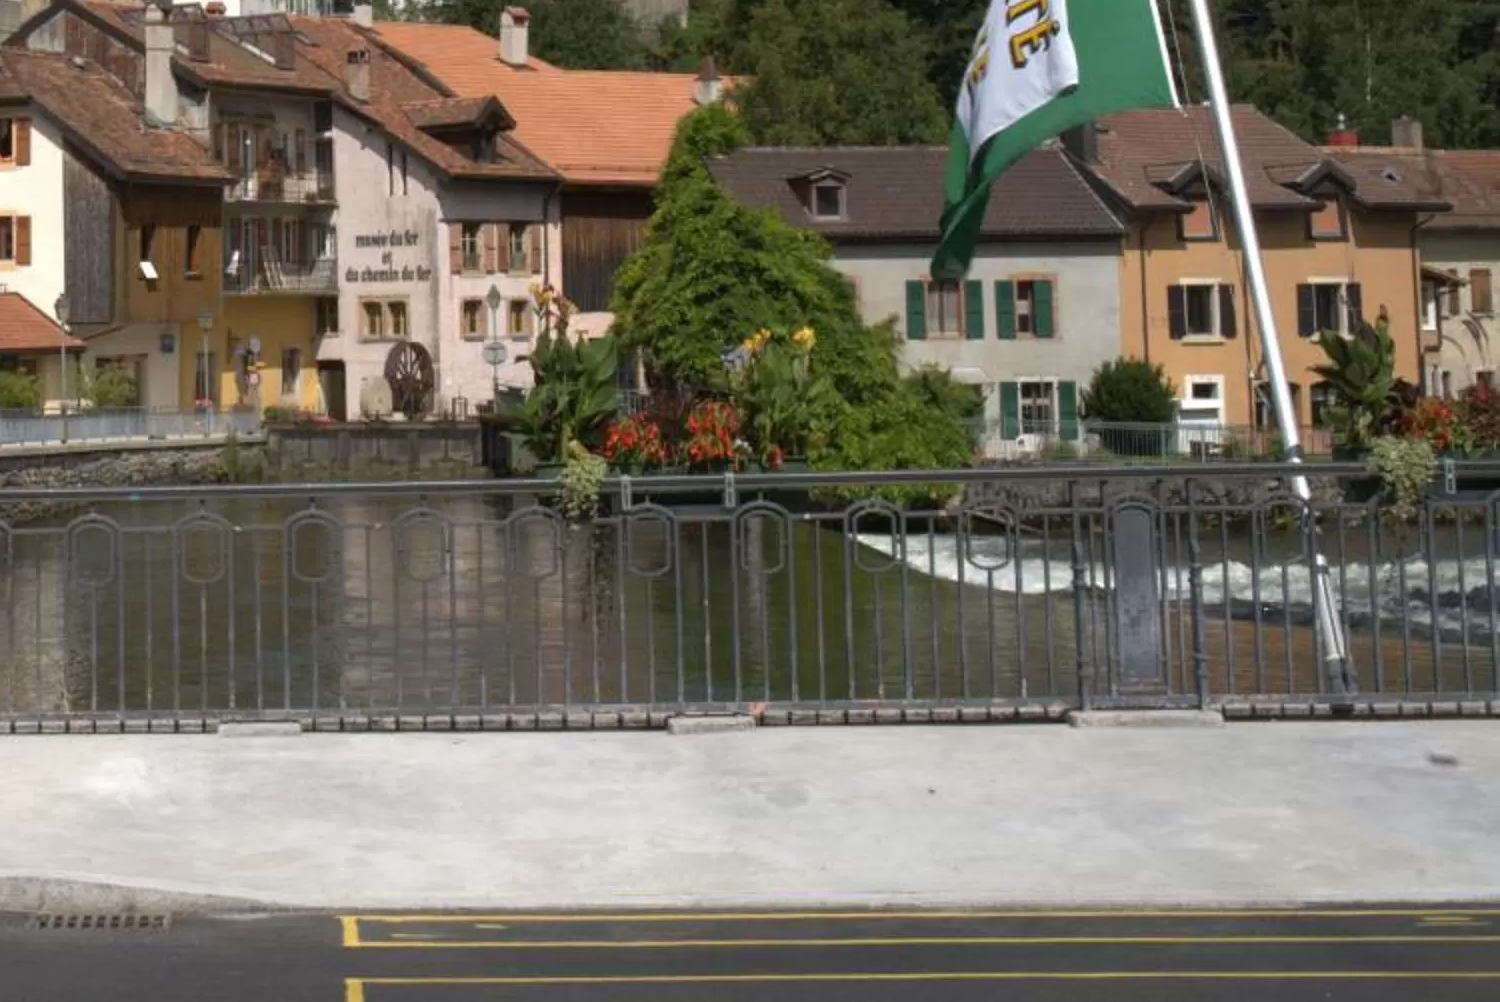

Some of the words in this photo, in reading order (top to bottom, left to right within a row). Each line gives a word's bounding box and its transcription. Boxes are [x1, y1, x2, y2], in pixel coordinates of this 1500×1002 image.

[389, 229, 403, 247] du
[404, 229, 419, 247] fer
[345, 265, 359, 282] du
[361, 264, 399, 282] chemin
[416, 264, 432, 282] fer
